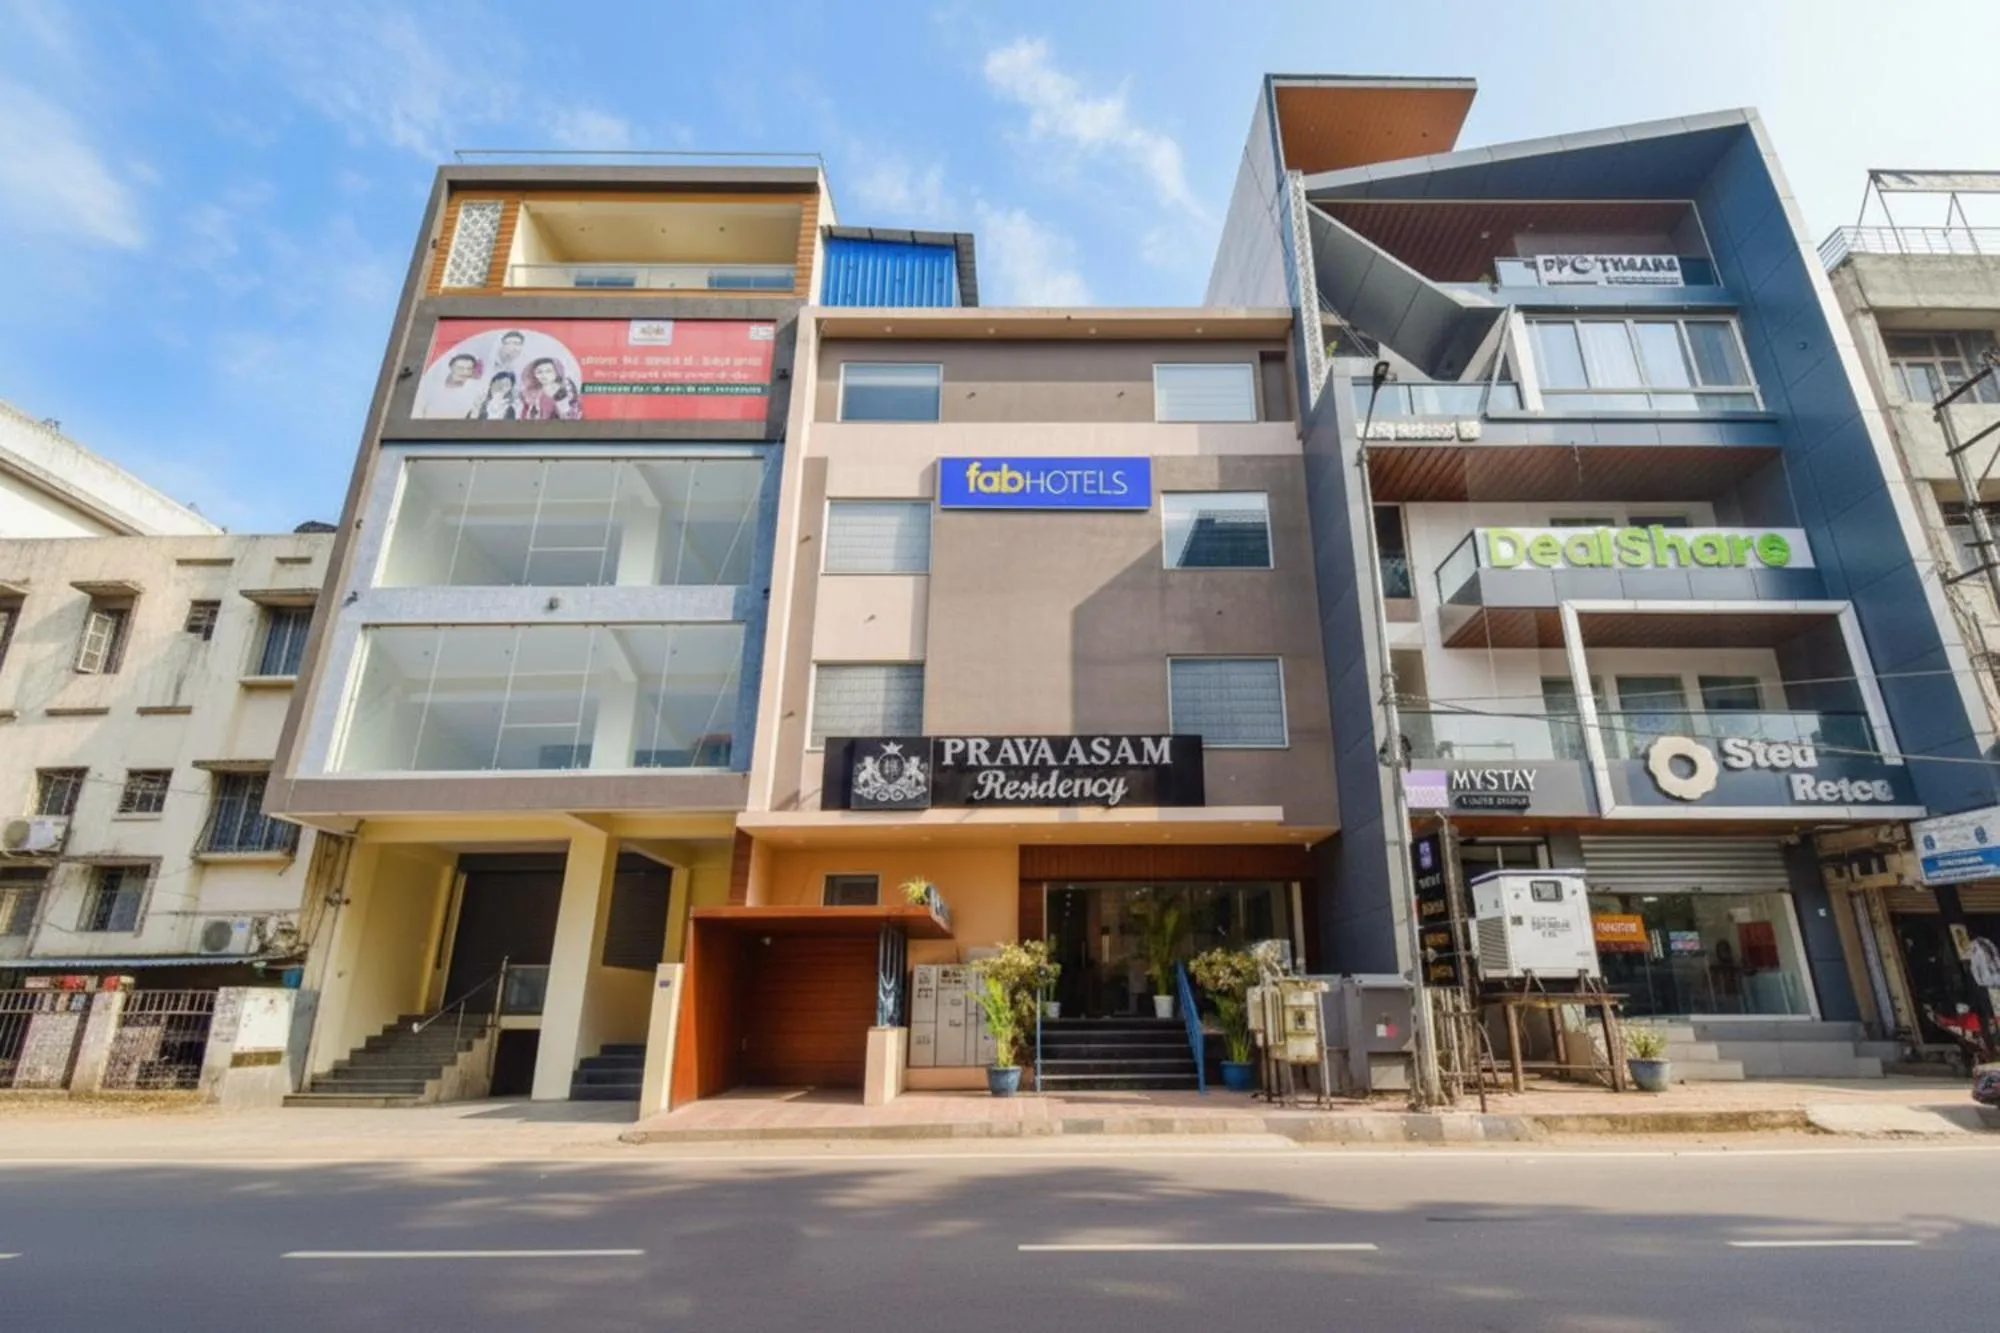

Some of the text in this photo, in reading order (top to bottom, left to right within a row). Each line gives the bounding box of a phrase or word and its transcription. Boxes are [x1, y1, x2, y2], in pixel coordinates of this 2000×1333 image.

[966, 461, 1129, 495] fabHOTELS
[1487, 524, 1792, 568] DealShare
[973, 770, 1129, 805] Residency
[1452, 768, 1537, 791] MYSTAY
